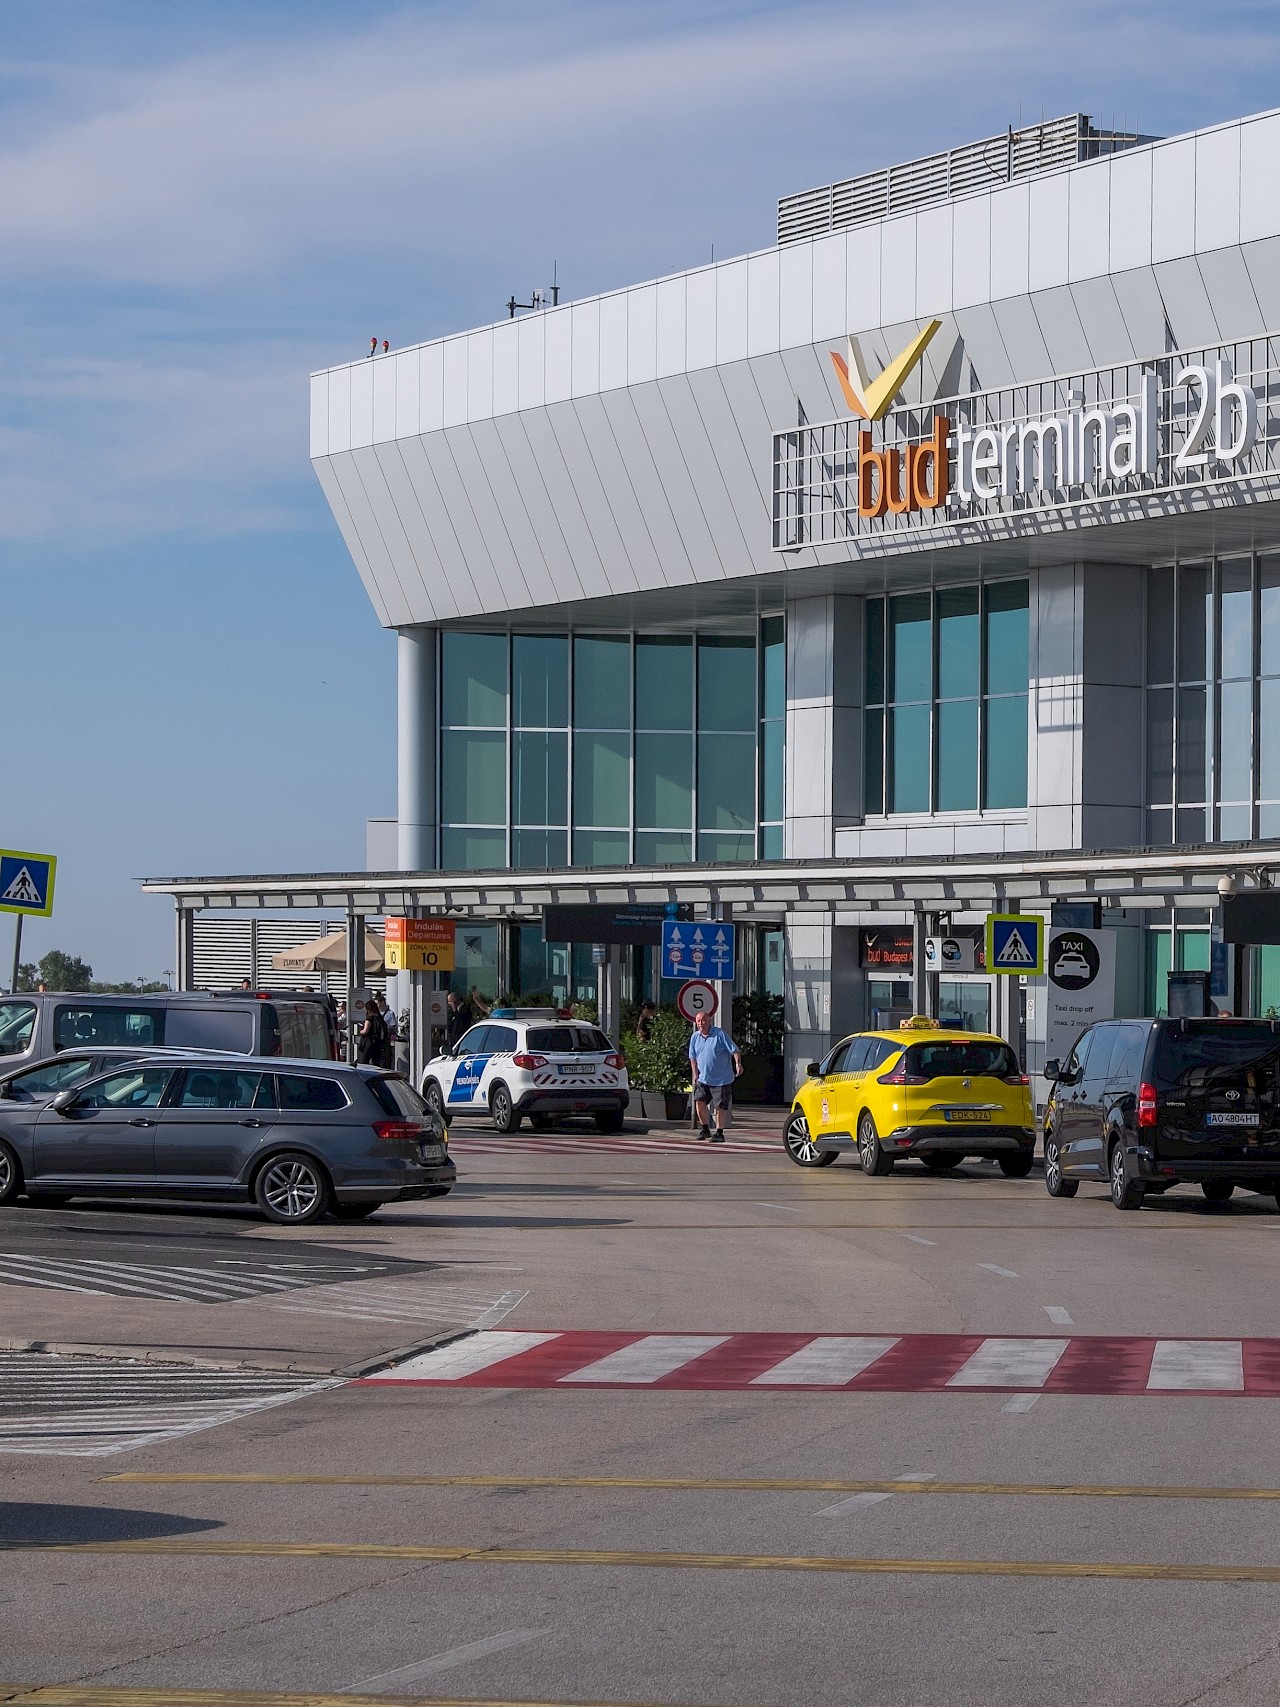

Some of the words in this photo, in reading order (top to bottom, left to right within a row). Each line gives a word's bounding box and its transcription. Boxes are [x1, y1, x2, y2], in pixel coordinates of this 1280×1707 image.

[1175, 360, 1256, 469] 2b
[414, 922, 444, 931] Indulás
[407, 930, 452, 940] Departures
[1060, 941, 1084, 951] TAXI
[422, 952, 438, 966] 10
[692, 993, 704, 1009] 5
[1055, 1004, 1068, 1012] Taxi
[1069, 1005, 1084, 1013] drop
[563, 1065, 593, 1074] PNR-907
[951, 1111, 988, 1120] EDK-524
